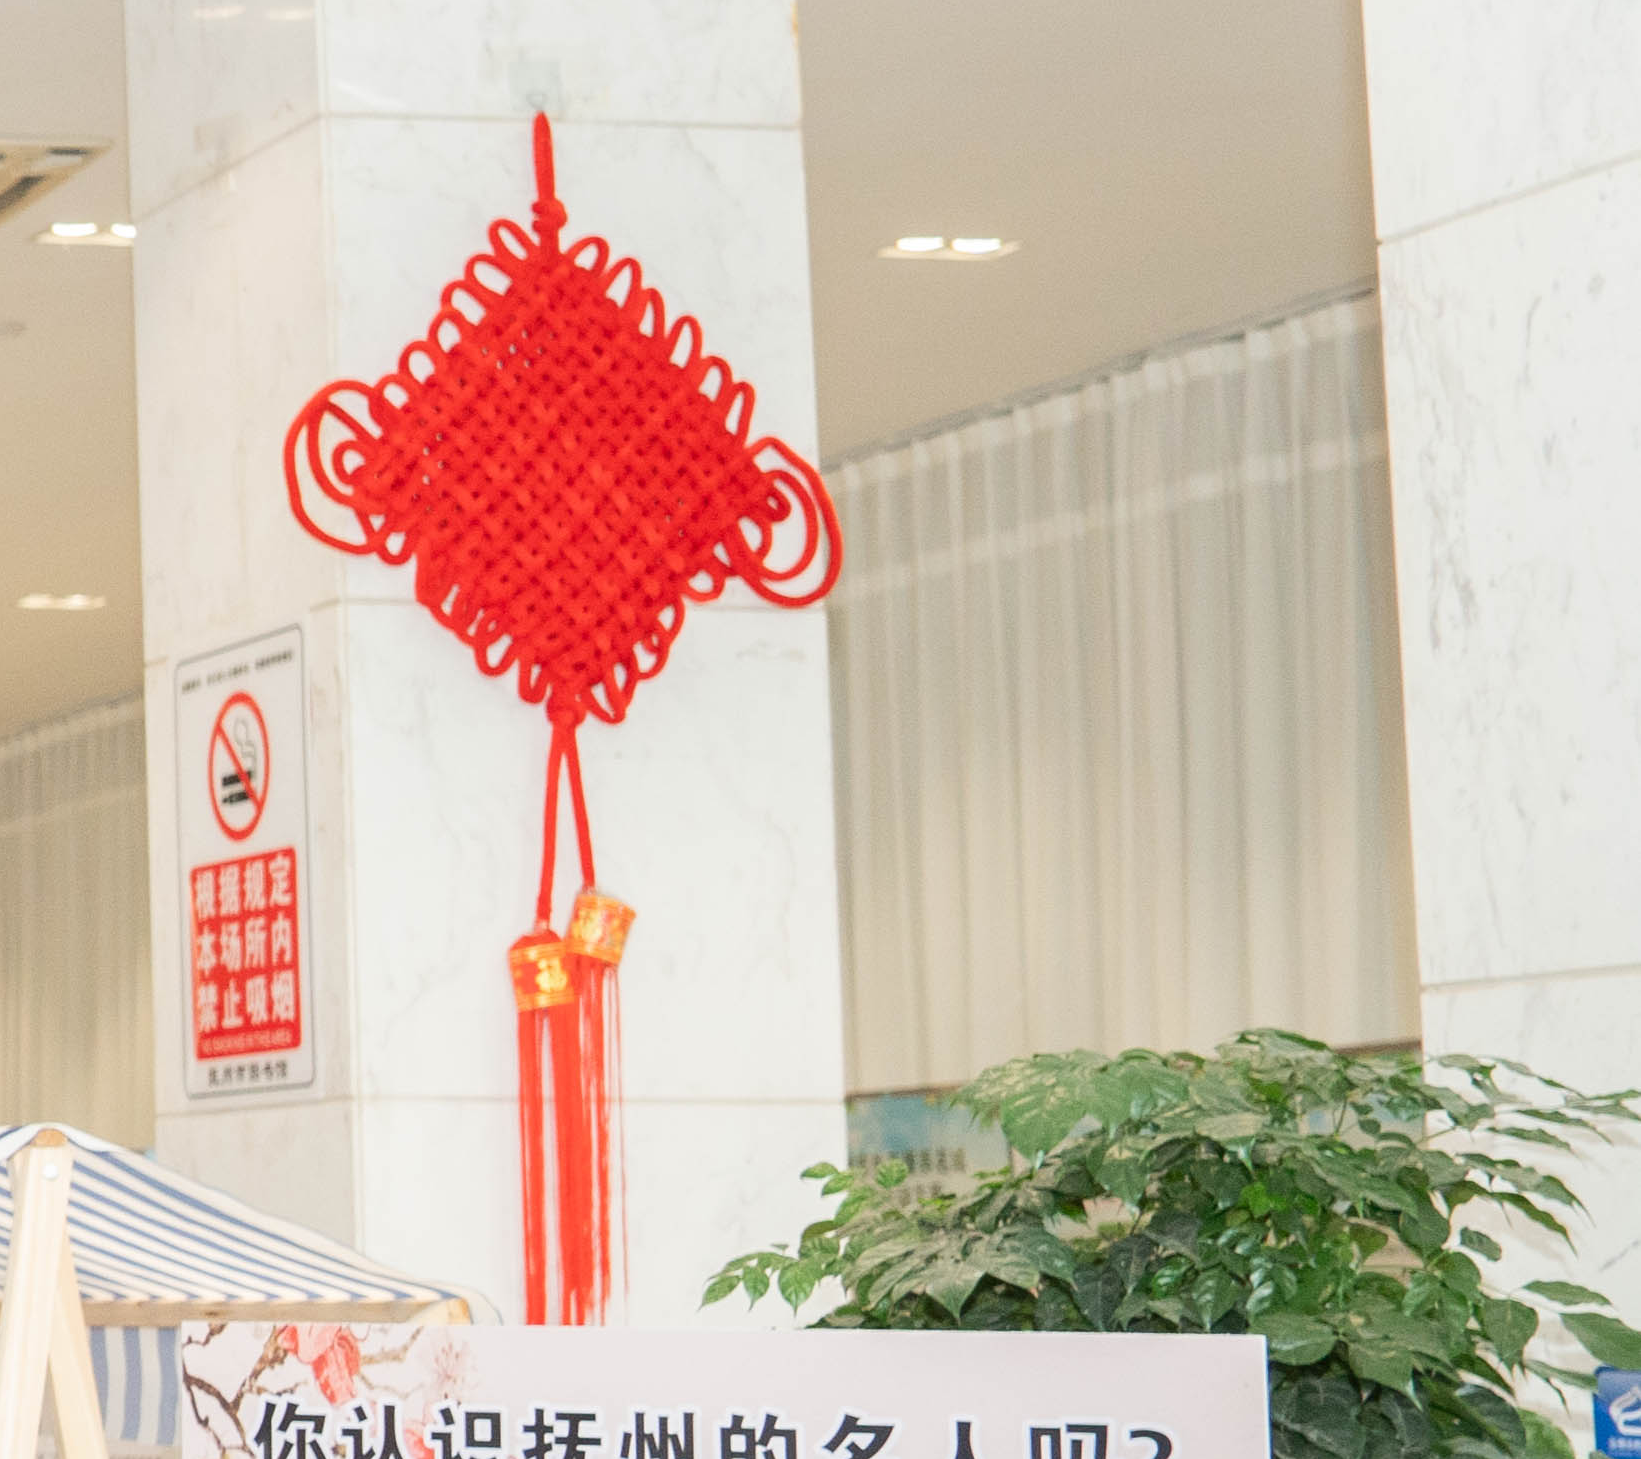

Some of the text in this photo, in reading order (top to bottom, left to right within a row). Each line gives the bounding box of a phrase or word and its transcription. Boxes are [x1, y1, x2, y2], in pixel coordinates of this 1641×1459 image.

[195, 853, 292, 919] 根据规定
[197, 911, 292, 976] 本场所内
[198, 969, 295, 1031] 禁止吸烟
